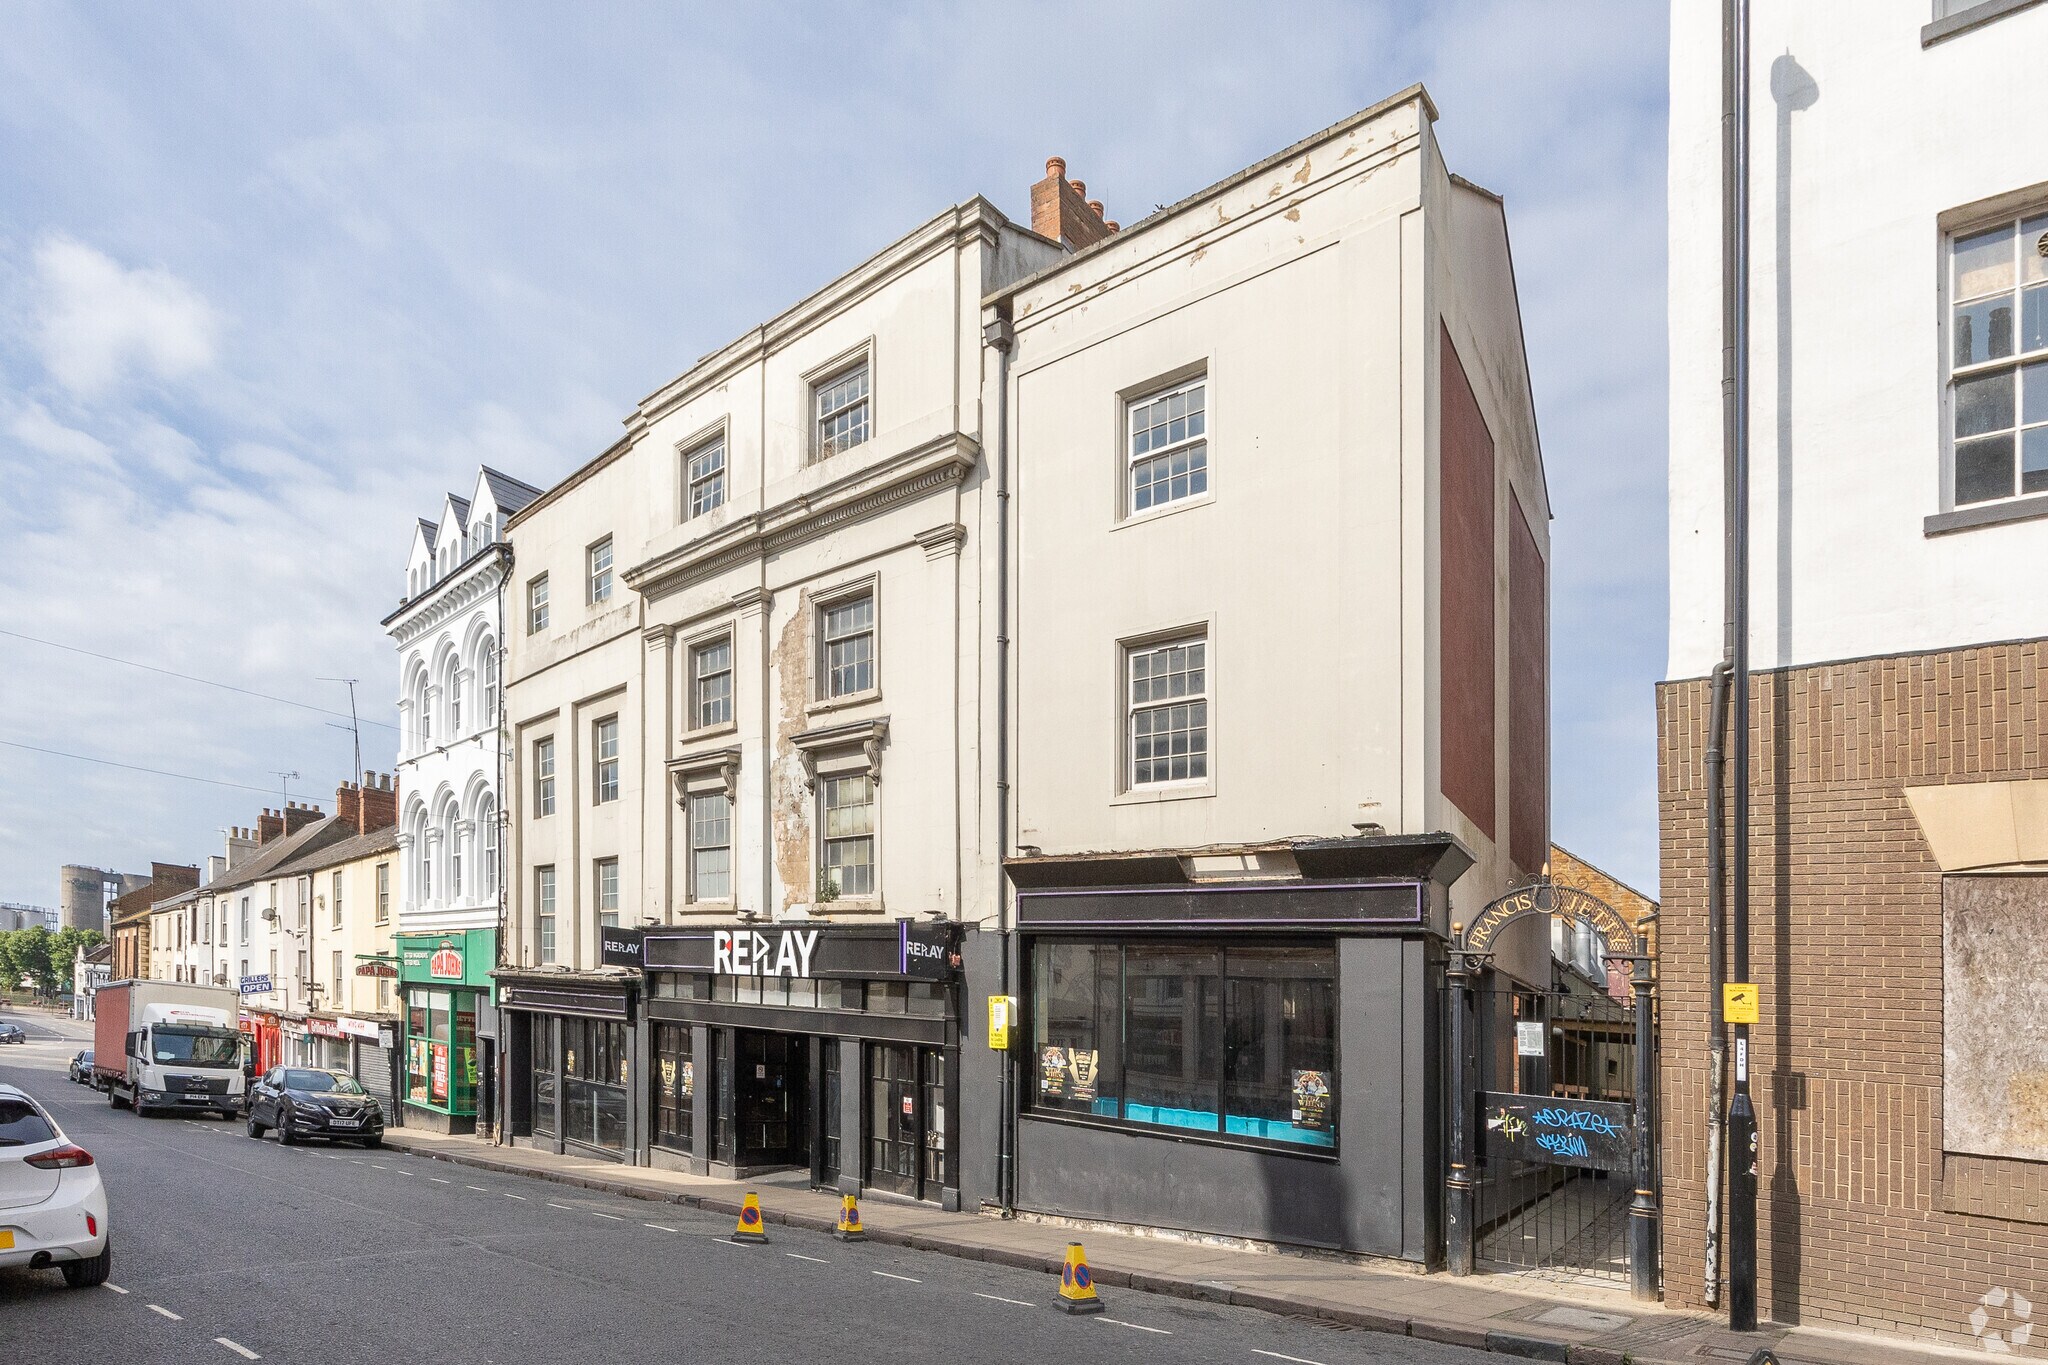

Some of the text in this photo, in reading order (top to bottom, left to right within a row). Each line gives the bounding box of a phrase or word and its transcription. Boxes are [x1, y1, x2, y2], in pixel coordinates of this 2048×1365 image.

[1468, 893, 1630, 949] FRANCIS JETTY
[604, 940, 640, 954] REPLAY
[714, 930, 819, 977] REPLAY
[906, 941, 945, 959] REPLAY
[358, 966, 375, 976] PAPA
[431, 952, 462, 977] PAPA JOHNS
[240, 974, 269, 983] GRILLERS
[242, 982, 271, 993] OPEN
